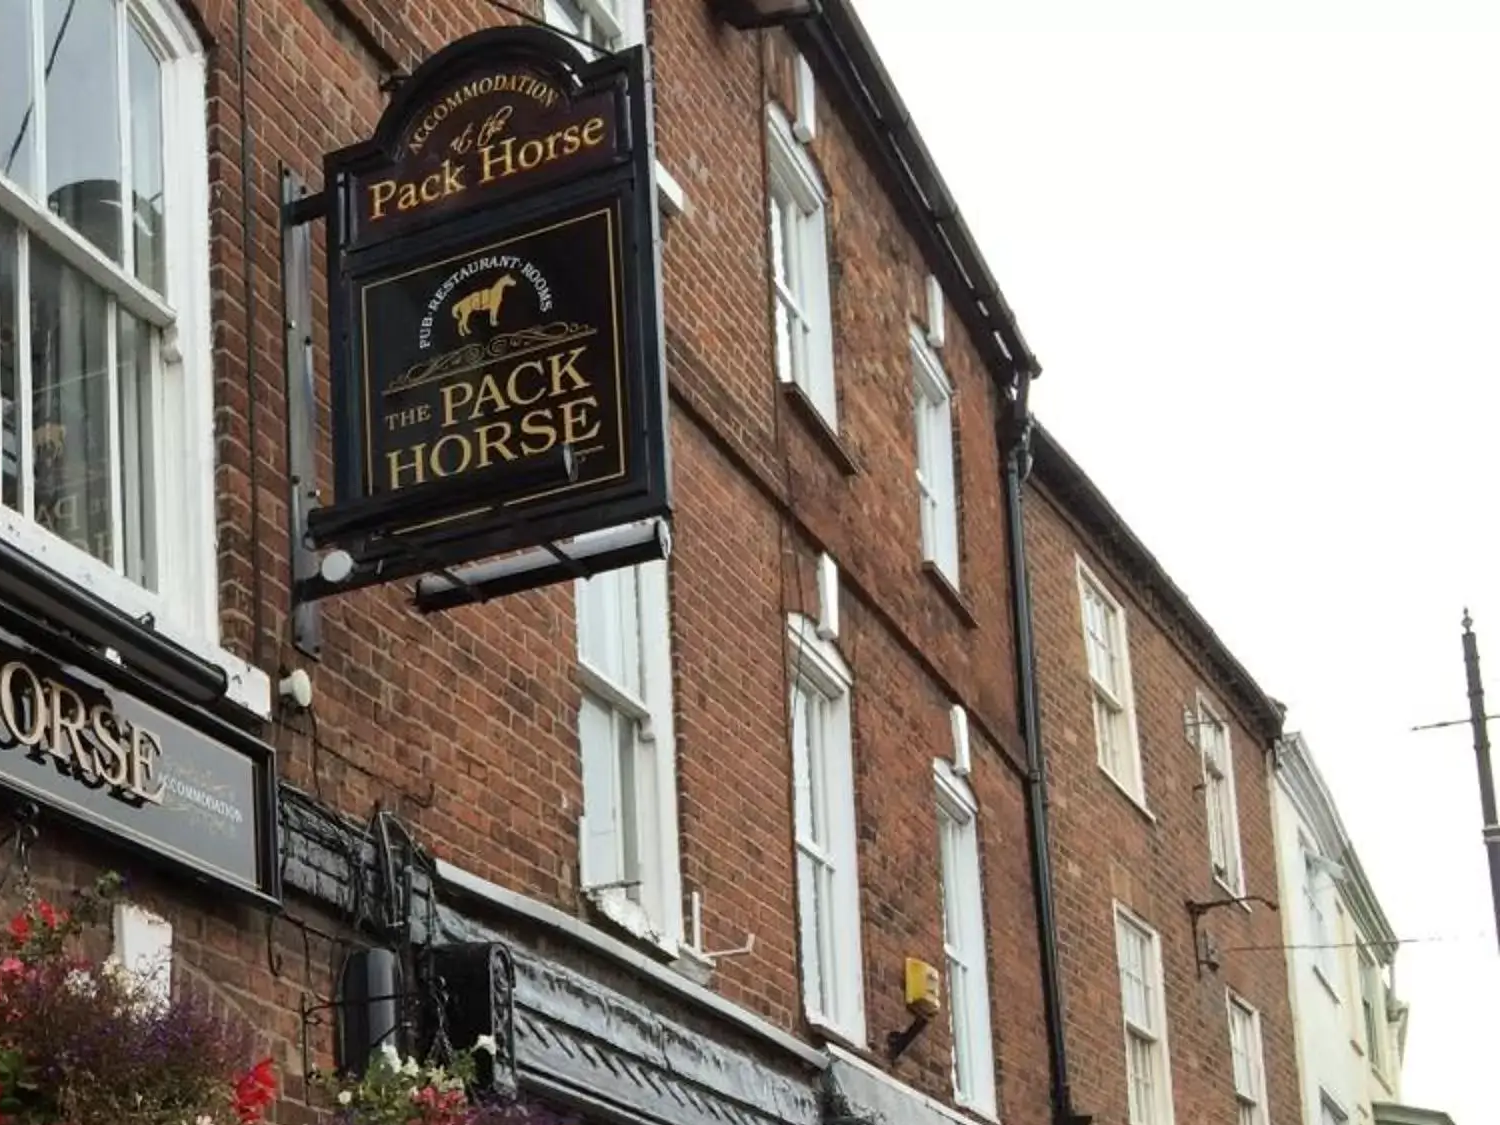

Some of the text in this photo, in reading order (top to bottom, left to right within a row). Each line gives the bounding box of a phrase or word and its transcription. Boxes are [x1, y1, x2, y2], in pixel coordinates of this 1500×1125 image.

[409, 74, 560, 155] ACCOMMODATION
[367, 114, 606, 221] Pack Horse
[384, 346, 593, 432] THE PACK
[385, 396, 602, 491] HORSE
